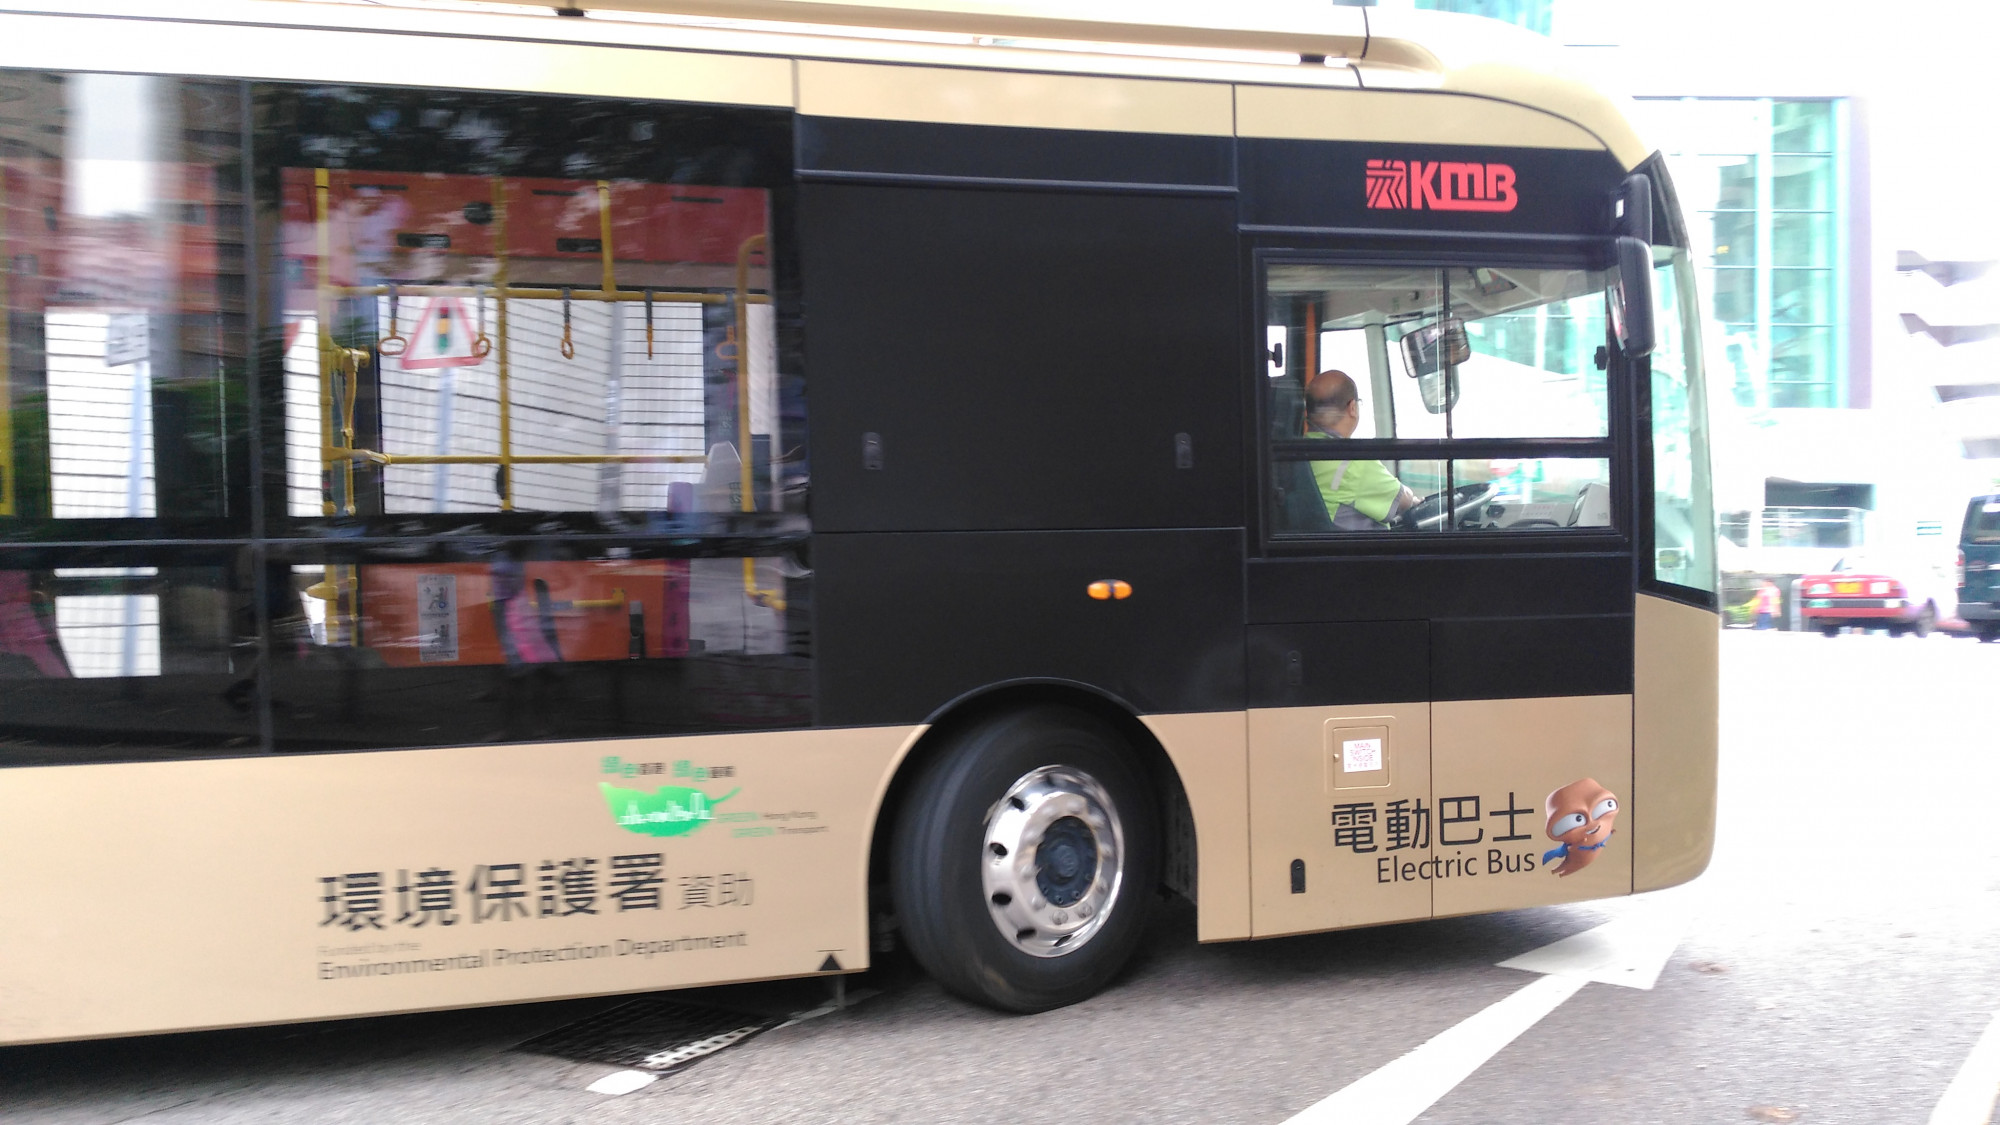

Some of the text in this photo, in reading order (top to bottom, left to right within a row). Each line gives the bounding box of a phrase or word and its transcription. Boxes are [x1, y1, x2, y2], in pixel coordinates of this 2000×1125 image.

[1410, 160, 1518, 213] KMB
[1331, 792, 1535, 853] 電動巴士
[317, 852, 754, 931] 環境保護署 資助
[1377, 849, 1535, 884] Electric Bus
[317, 931, 748, 980] Environmental Protection Department
